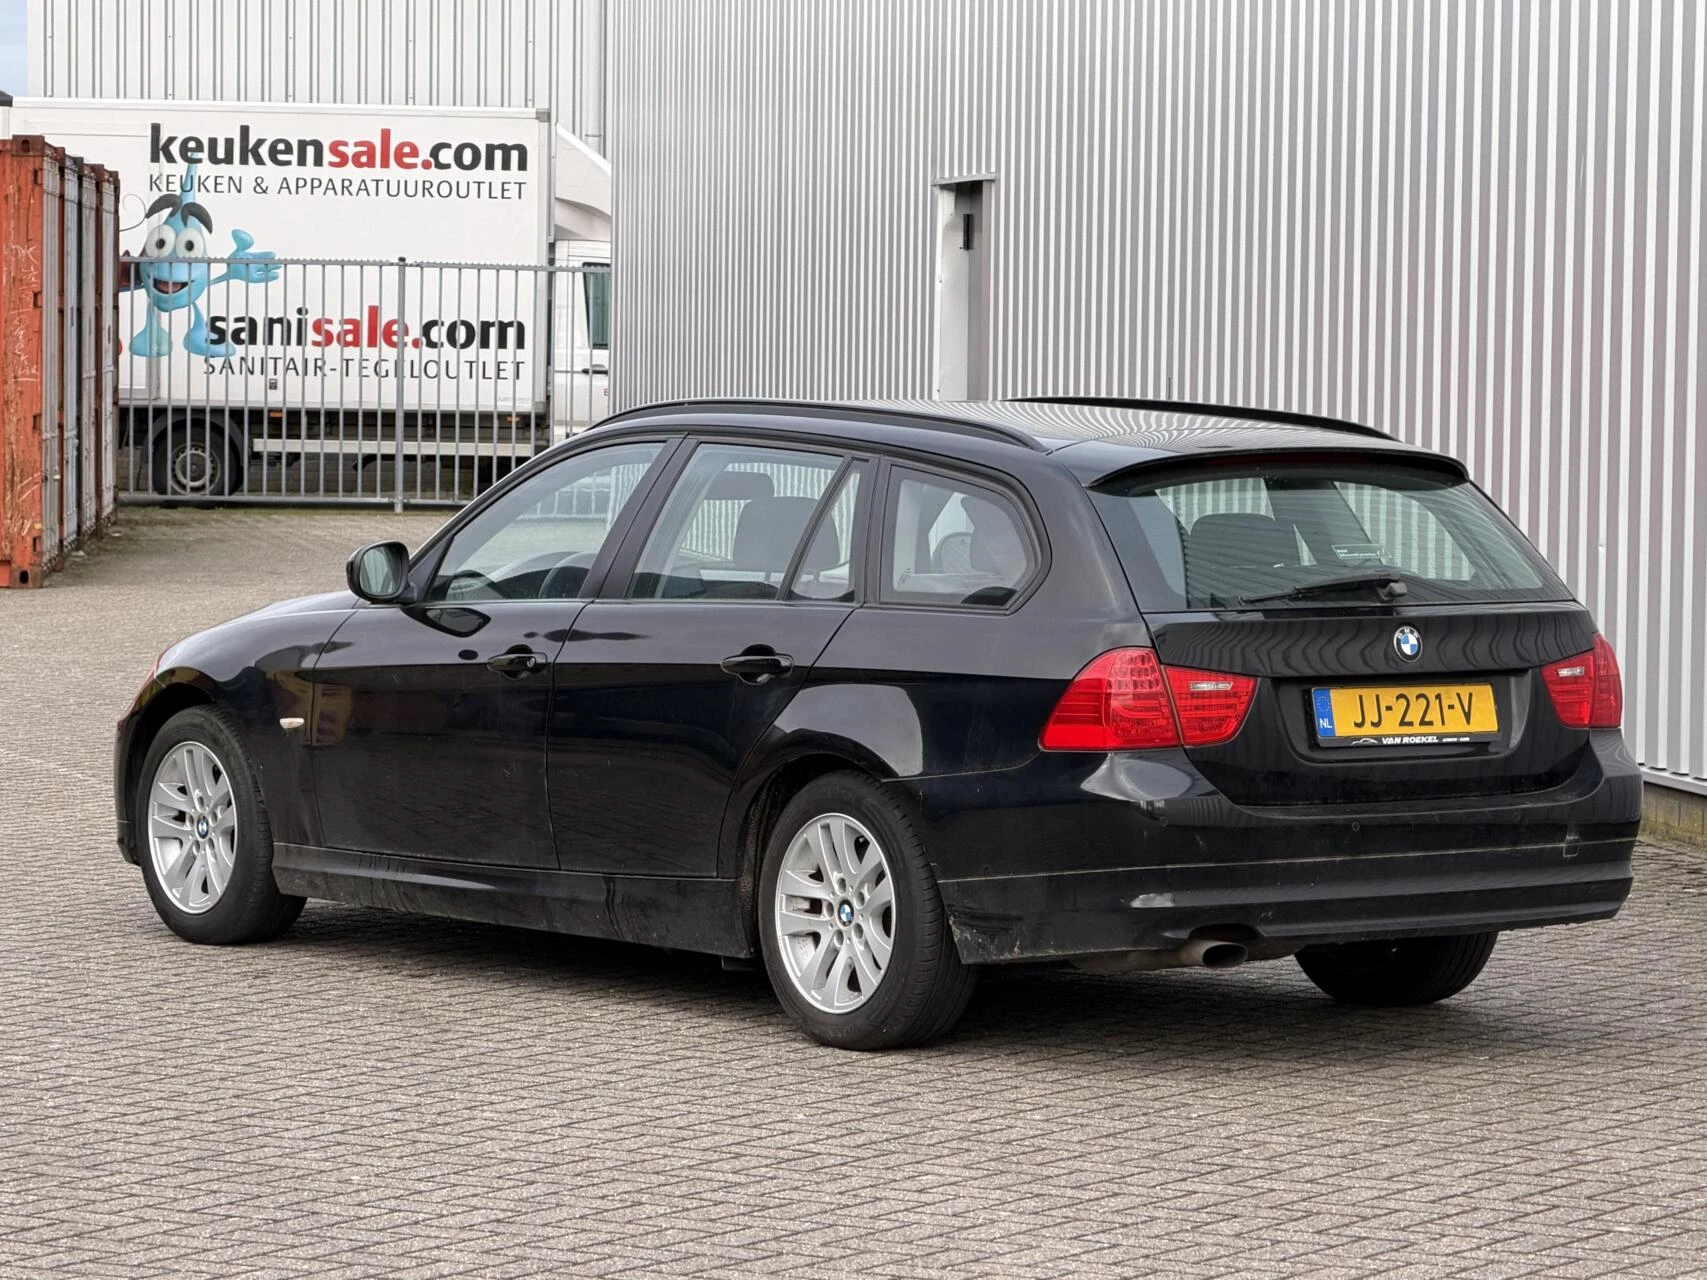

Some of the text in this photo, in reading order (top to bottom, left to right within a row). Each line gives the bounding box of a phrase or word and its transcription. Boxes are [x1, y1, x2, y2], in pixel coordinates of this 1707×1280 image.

[150, 122, 528, 171] keukensale.com
[149, 174, 527, 200] KEUKEN & APPARATUUROUTLET
[205, 305, 525, 350] sanisale.com
[1320, 718, 1332, 729] NL
[1353, 692, 1472, 728] JJ-221-V
[1381, 736, 1401, 744] VAN
[1402, 735, 1438, 744] ROEKEL
